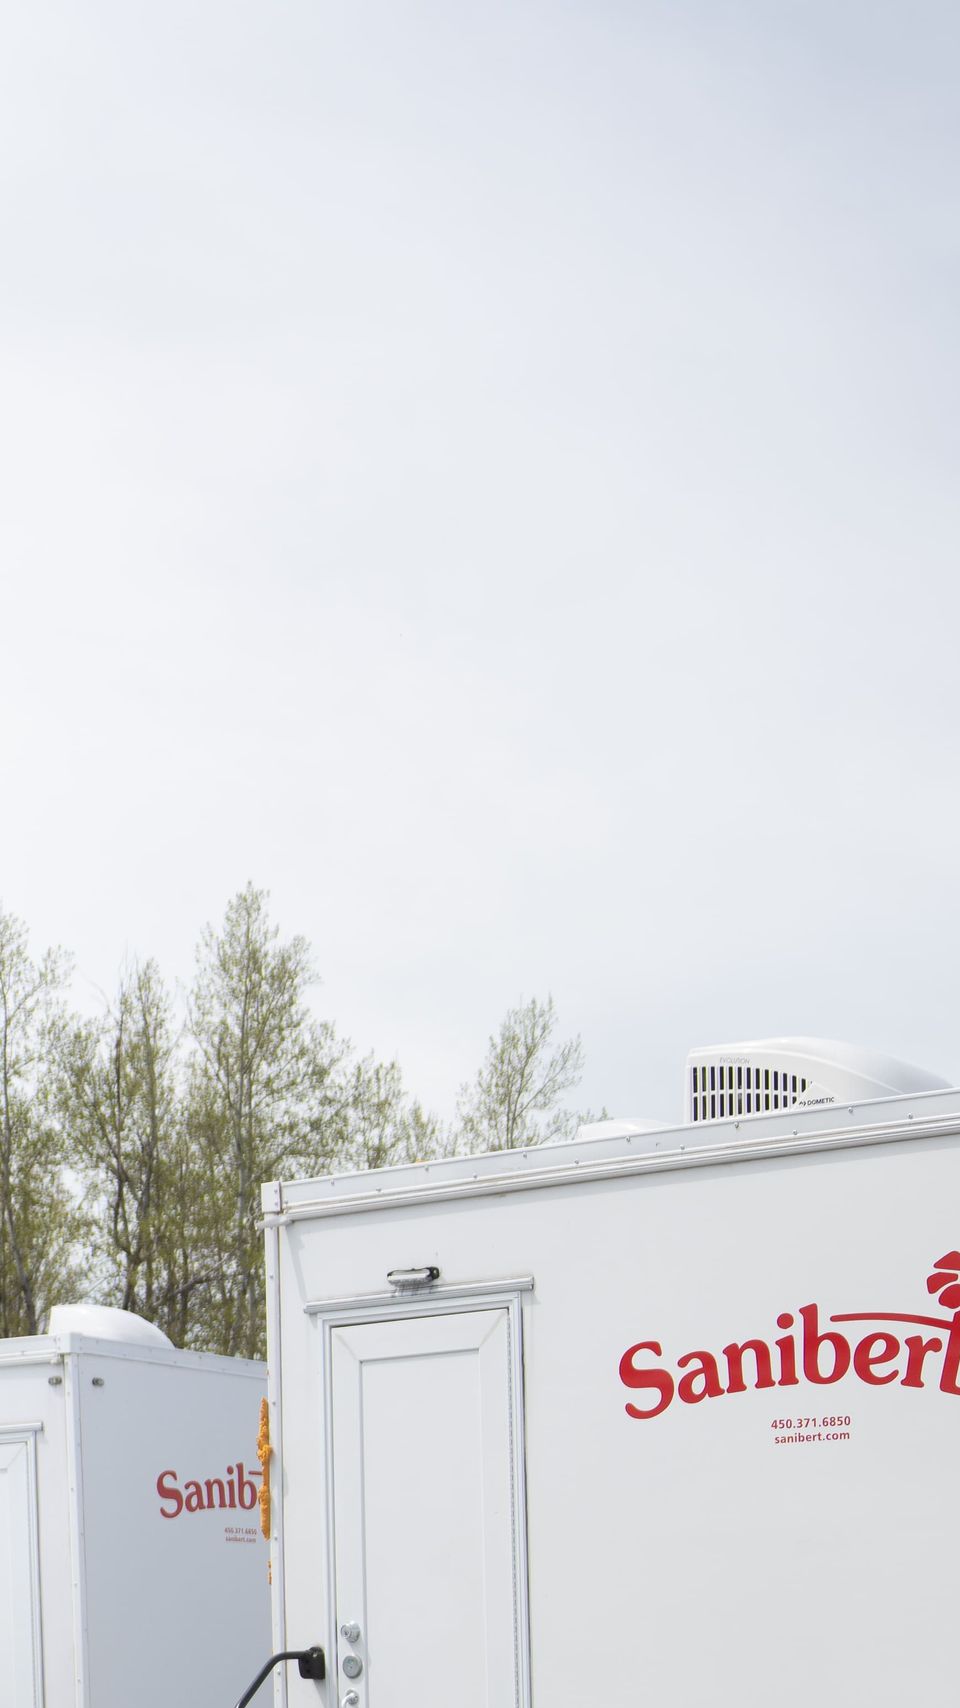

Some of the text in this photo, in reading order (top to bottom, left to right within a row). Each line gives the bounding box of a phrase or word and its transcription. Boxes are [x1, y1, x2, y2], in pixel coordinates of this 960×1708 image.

[807, 1096, 835, 1106] DOMETIC
[770, 1415, 851, 1430] 450.371.6850
[774, 1431, 850, 1444] sanibert.com
[156, 1462, 262, 1519] Sanib
